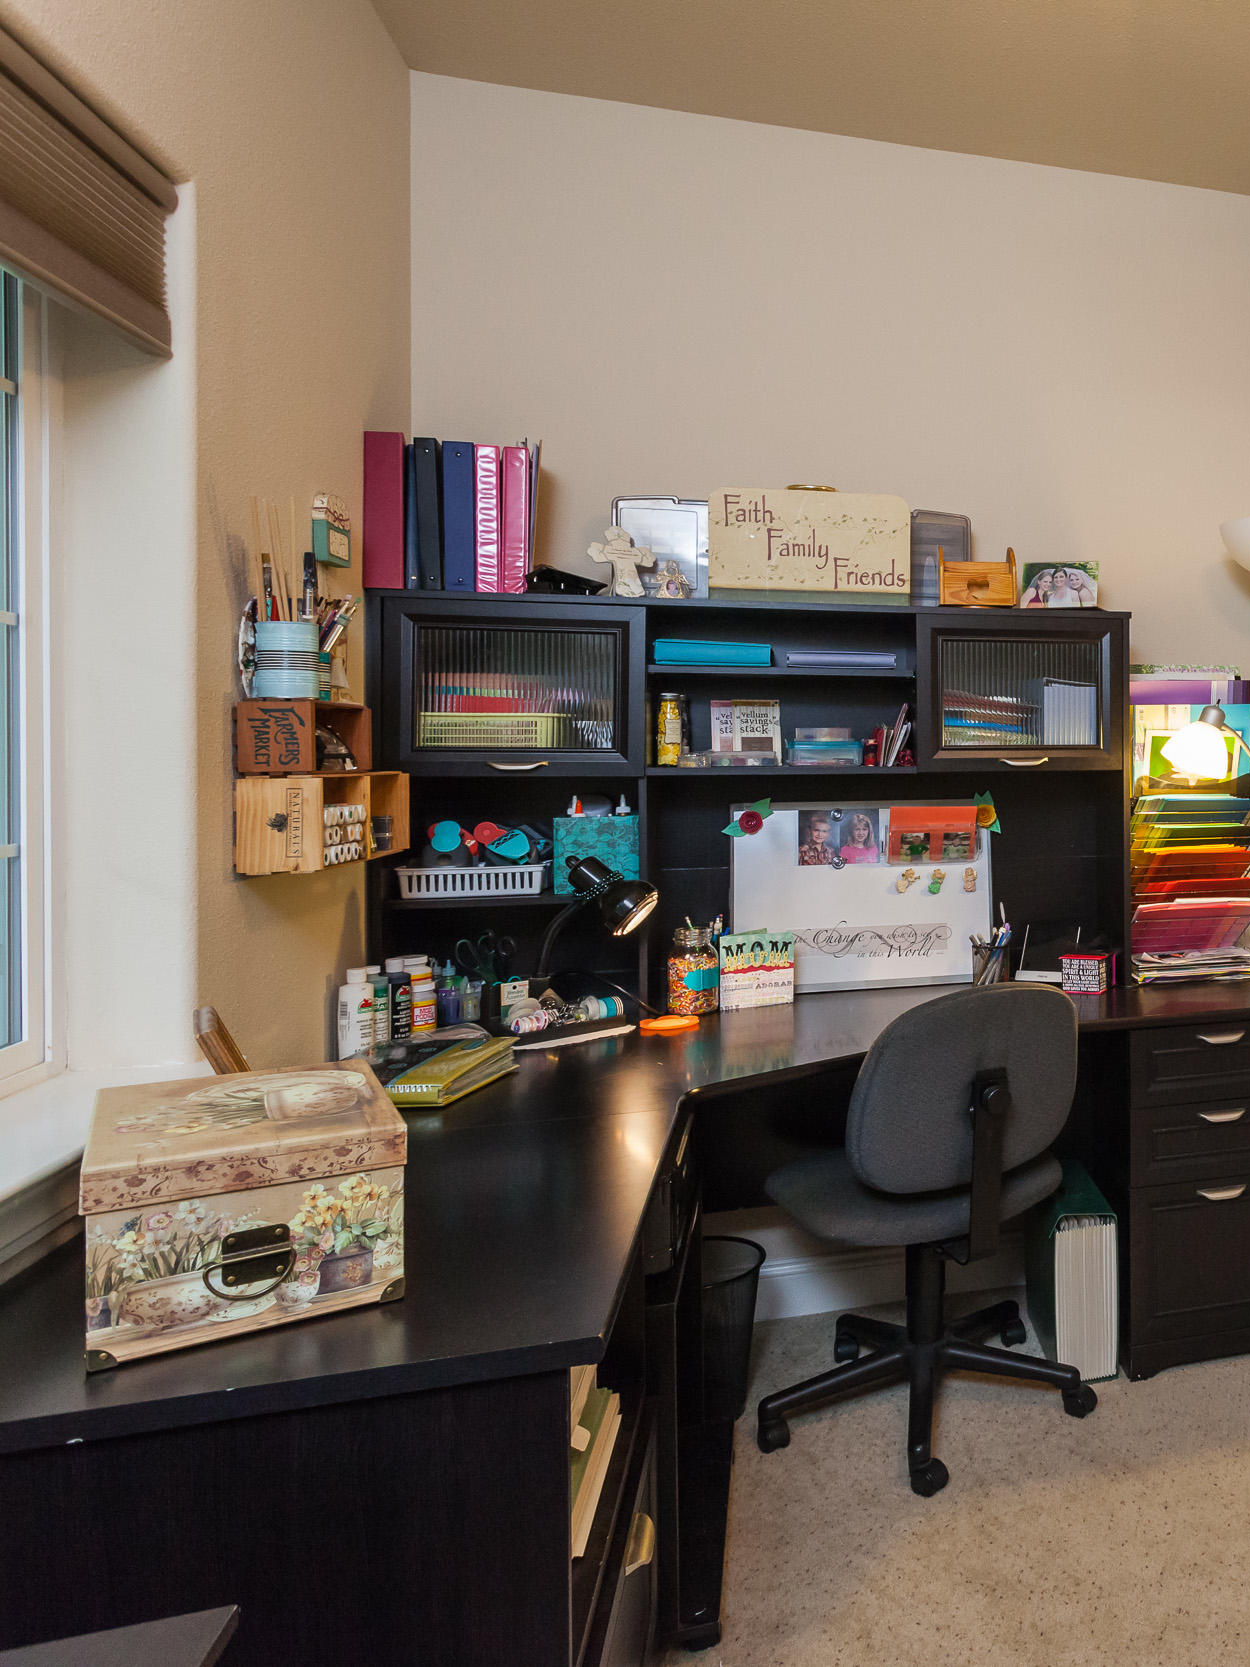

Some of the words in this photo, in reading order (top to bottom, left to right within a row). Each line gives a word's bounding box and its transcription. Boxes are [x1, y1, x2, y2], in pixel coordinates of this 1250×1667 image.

[723, 494, 774, 527] Faith
[767, 528, 829, 570] Family
[833, 557, 906, 590] Friends
[721, 711, 732, 719] vel
[740, 725, 769, 734] stack
[248, 718, 271, 767] MARKET
[256, 706, 305, 766] FARMERS
[292, 792, 301, 855] NATURALS
[722, 940, 792, 973] MOM
[812, 926, 865, 957] Change
[886, 936, 932, 958] World
